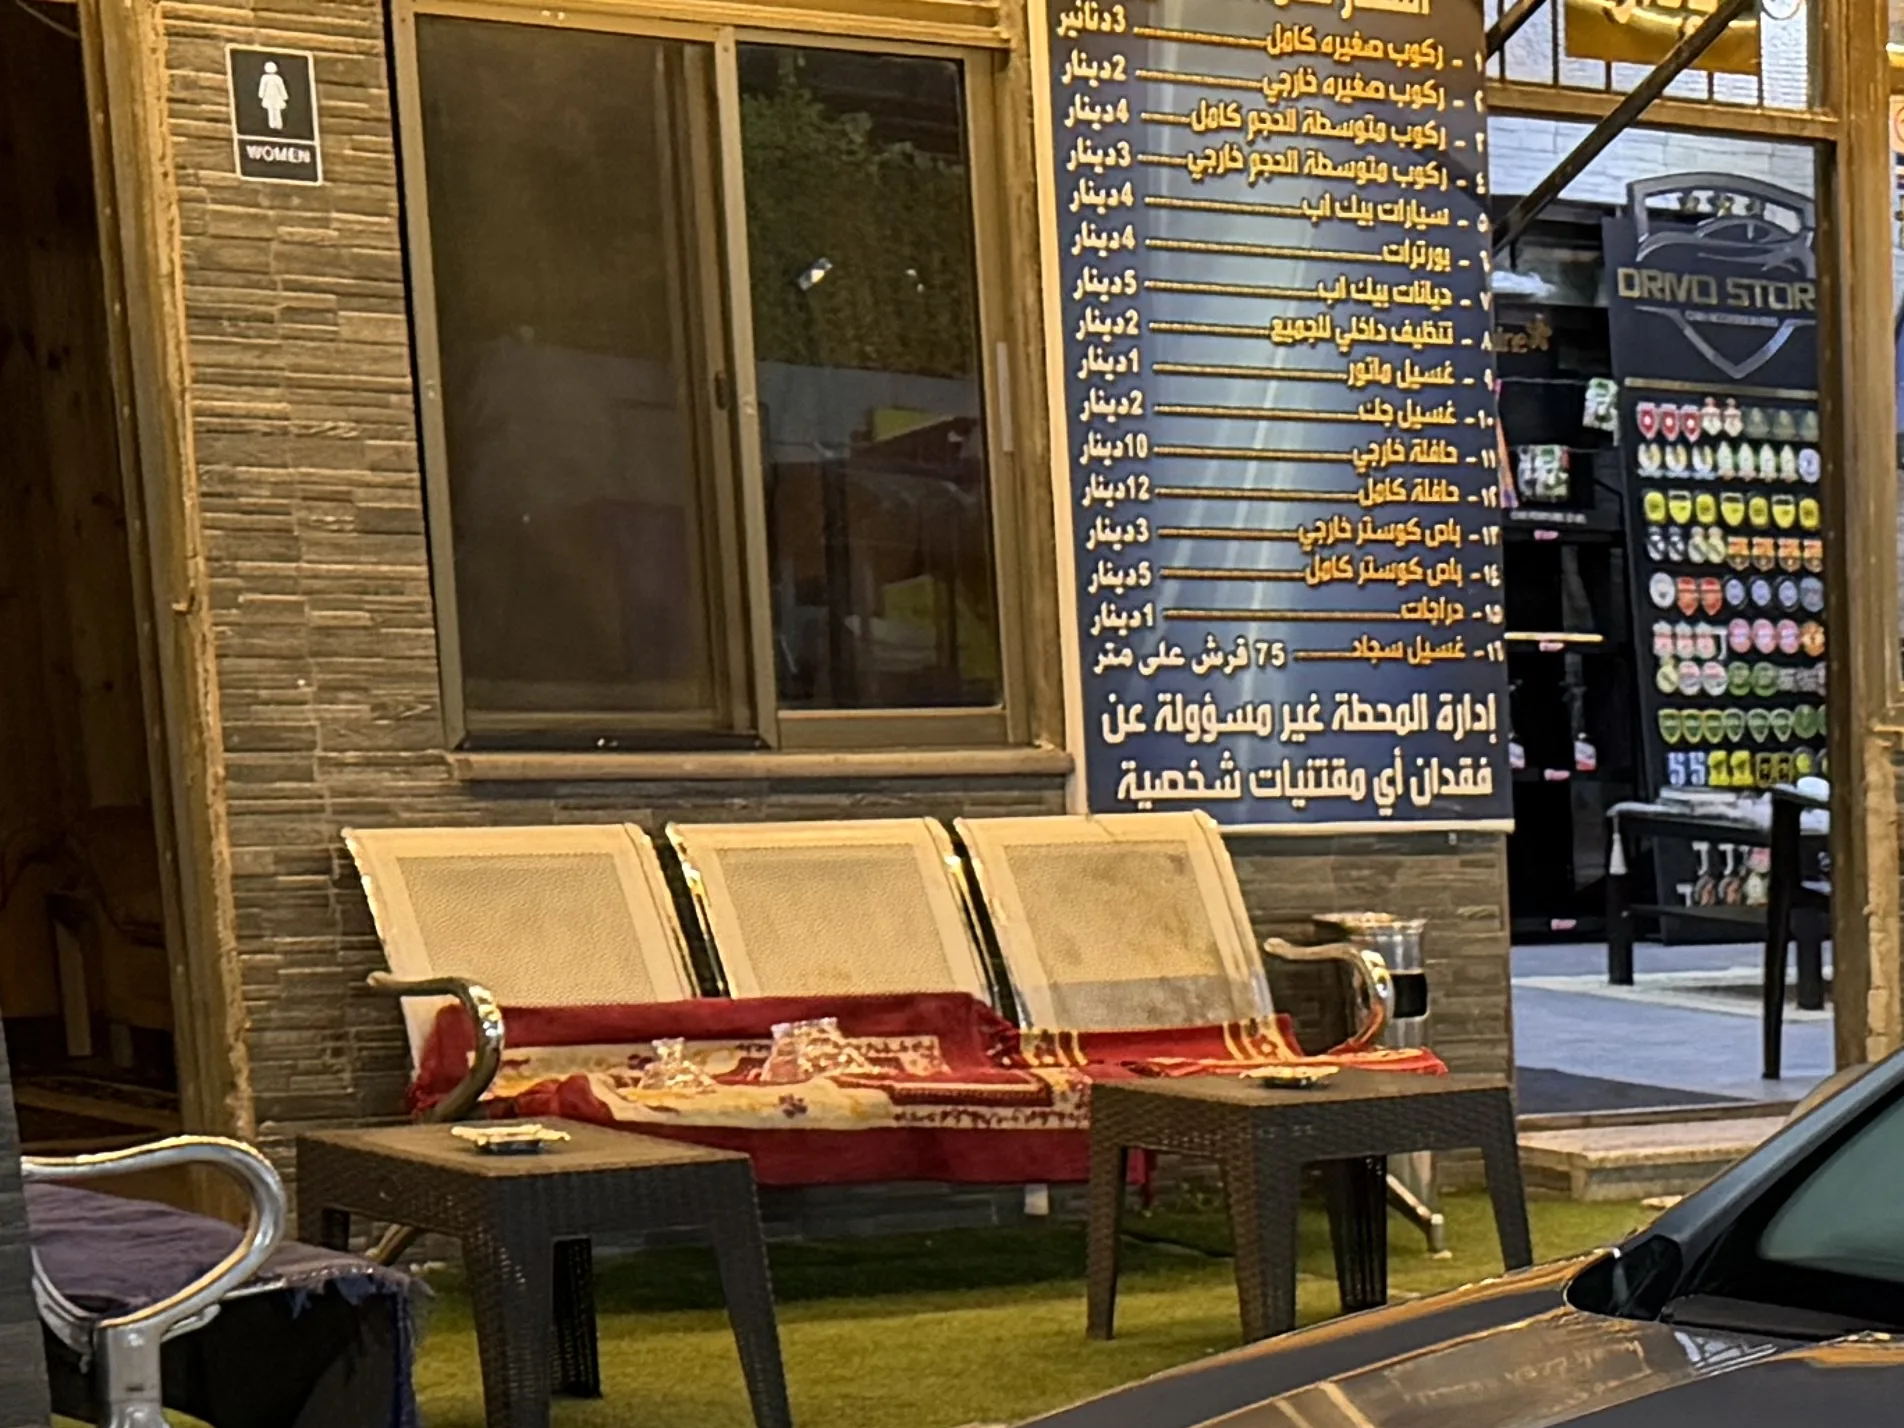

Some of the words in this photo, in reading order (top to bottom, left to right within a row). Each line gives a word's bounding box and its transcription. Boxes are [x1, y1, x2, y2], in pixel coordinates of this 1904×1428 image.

[1266, 22, 1316, 55] كامل
[1321, 31, 1384, 61] صغيره
[1388, 38, 1444, 70] ركوب
[1262, 67, 1318, 104] خارجي
[1322, 73, 1385, 103] صغيره
[1389, 79, 1445, 111] ركوب
[1190, 100, 1241, 131] كامل
[1247, 108, 1297, 140] الحجم
[1302, 108, 1387, 144] متوسطة
[1391, 120, 1446, 150] ركوب
[246, 145, 311, 163] WOMEN
[1187, 142, 1244, 180] خارجي
[1248, 149, 1299, 182] الحجم
[1303, 150, 1388, 185] متوسطة
[1392, 161, 1447, 191] ركوب
[1302, 192, 1331, 223] اب
[1335, 194, 1374, 226] بيك
[1377, 198, 1449, 230] سيارات
[1317, 275, 1347, 305] اب
[1351, 276, 1390, 309] بيك
[1726, 277, 1816, 310] STOR
[1271, 314, 1332, 345] للجميع
[1335, 316, 1388, 353] داخلي
[1390, 319, 1453, 350] تنظيف
[1348, 356, 1392, 388] ماتور
[1396, 358, 1455, 389] غسيل
[1398, 398, 1457, 430] غسيل
[1352, 437, 1405, 474] خارجي
[1410, 438, 1458, 463] حافلة
[1358, 477, 1407, 507] كامل
[1411, 478, 1460, 503] حافلة
[1298, 514, 1352, 552] خارجي
[1356, 516, 1422, 547] كوستر
[1425, 517, 1461, 548] باص
[1305, 554, 1354, 585] كامل
[1357, 555, 1424, 587] كوستر
[1426, 557, 1463, 588] باص
[1401, 596, 1464, 626] دراجات
[1093, 641, 1133, 675] متر
[1138, 641, 1185, 676] على
[1191, 632, 1248, 675] قرش
[1255, 641, 1285, 667] 75
[1352, 634, 1404, 664] سجاد
[1407, 635, 1466, 665] غسيل
[1102, 693, 1147, 744] عن
[1154, 692, 1272, 743] مسؤولة
[1280, 693, 1324, 742] غير
[1331, 693, 1429, 736] المحطة
[1436, 693, 1497, 744] إدارة
[1117, 750, 1242, 810] شخصية
[1249, 758, 1366, 808] مقتنيات
[1372, 746, 1404, 817] أي
[1410, 757, 1493, 807] فقدان
